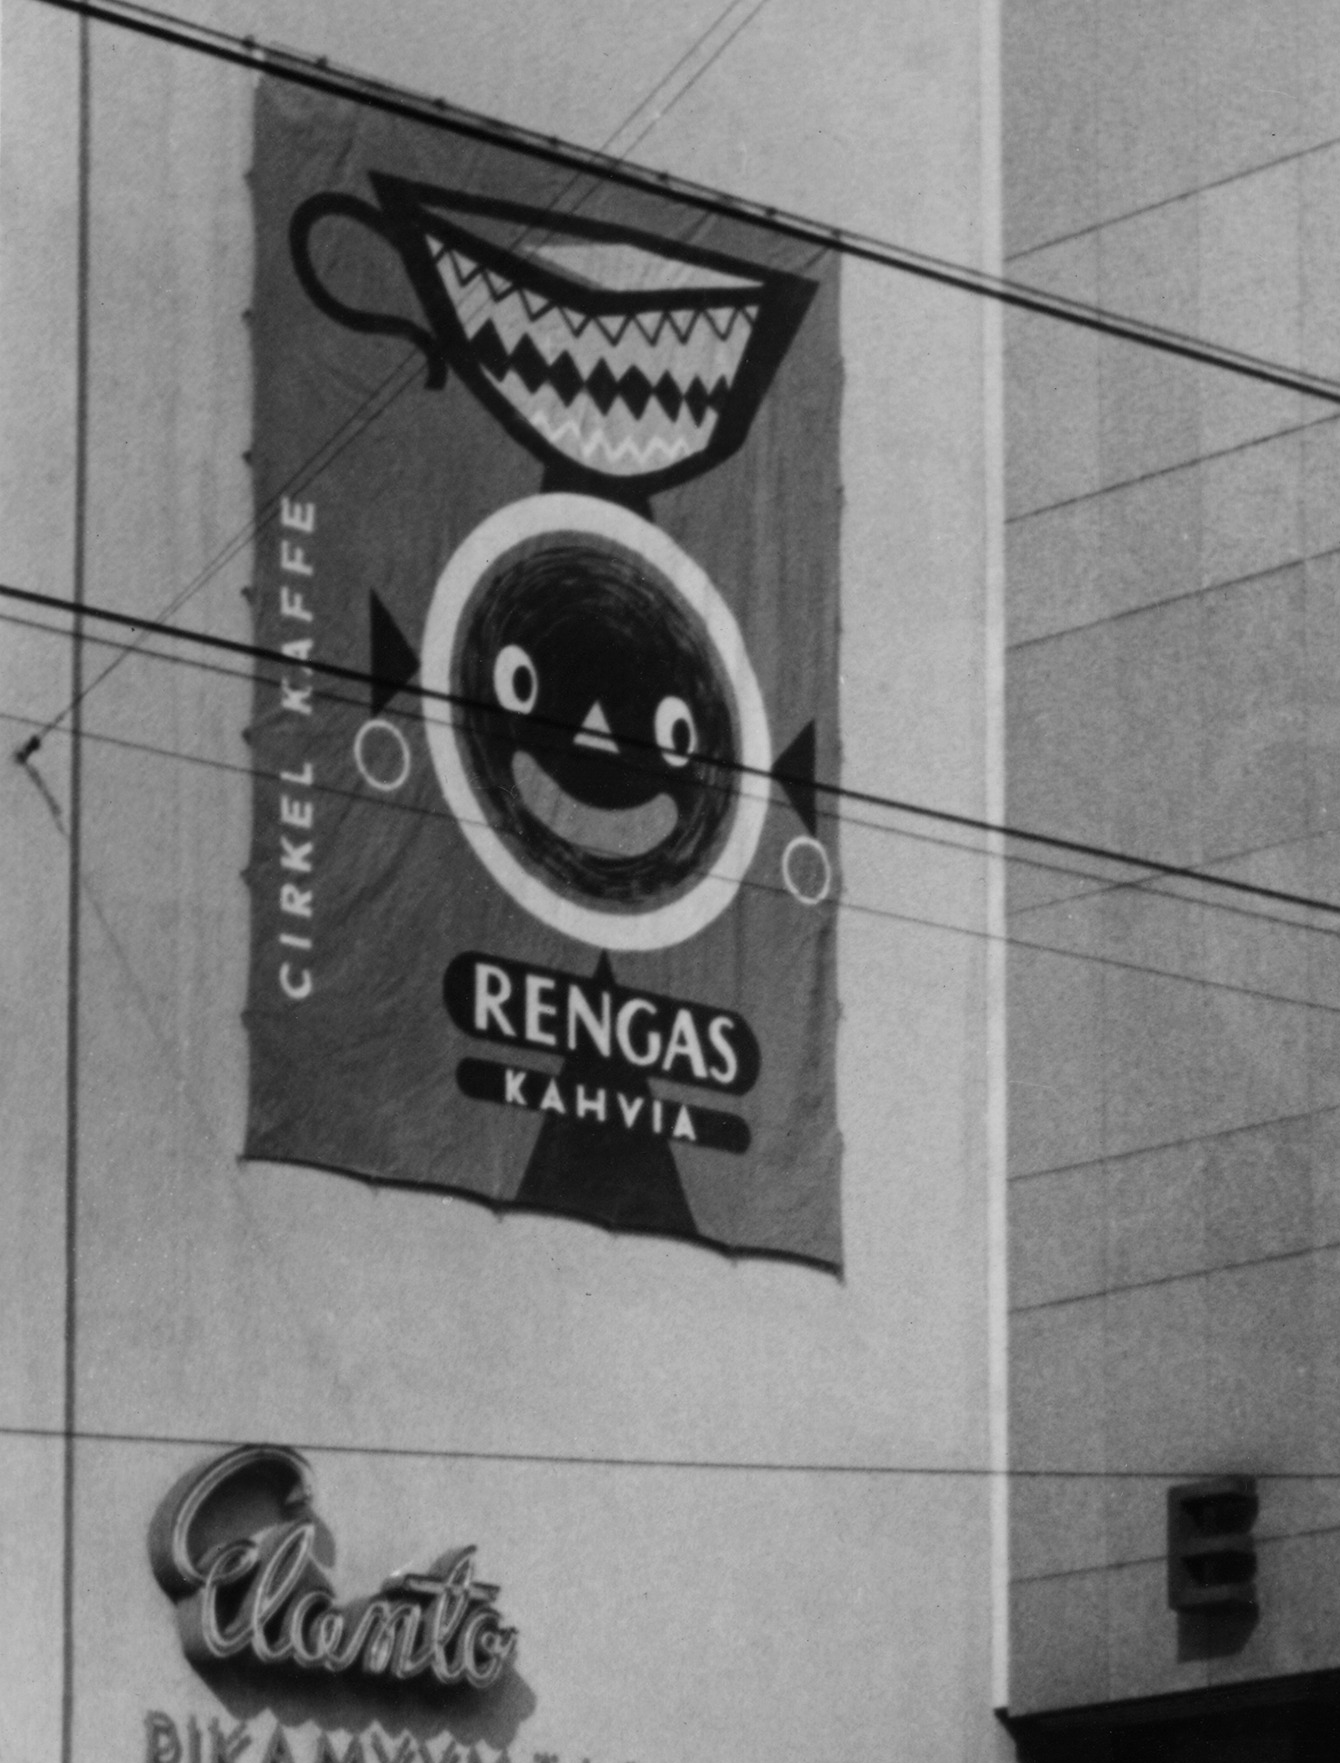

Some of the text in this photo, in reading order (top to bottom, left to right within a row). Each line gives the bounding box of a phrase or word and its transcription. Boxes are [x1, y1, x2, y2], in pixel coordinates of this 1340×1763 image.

[280, 495, 315, 1000] CIRKEL KAFFE
[474, 962, 738, 1086] RENGAS
[505, 1068, 696, 1142] KAHVIA
[165, 1443, 518, 1690] Elanto
